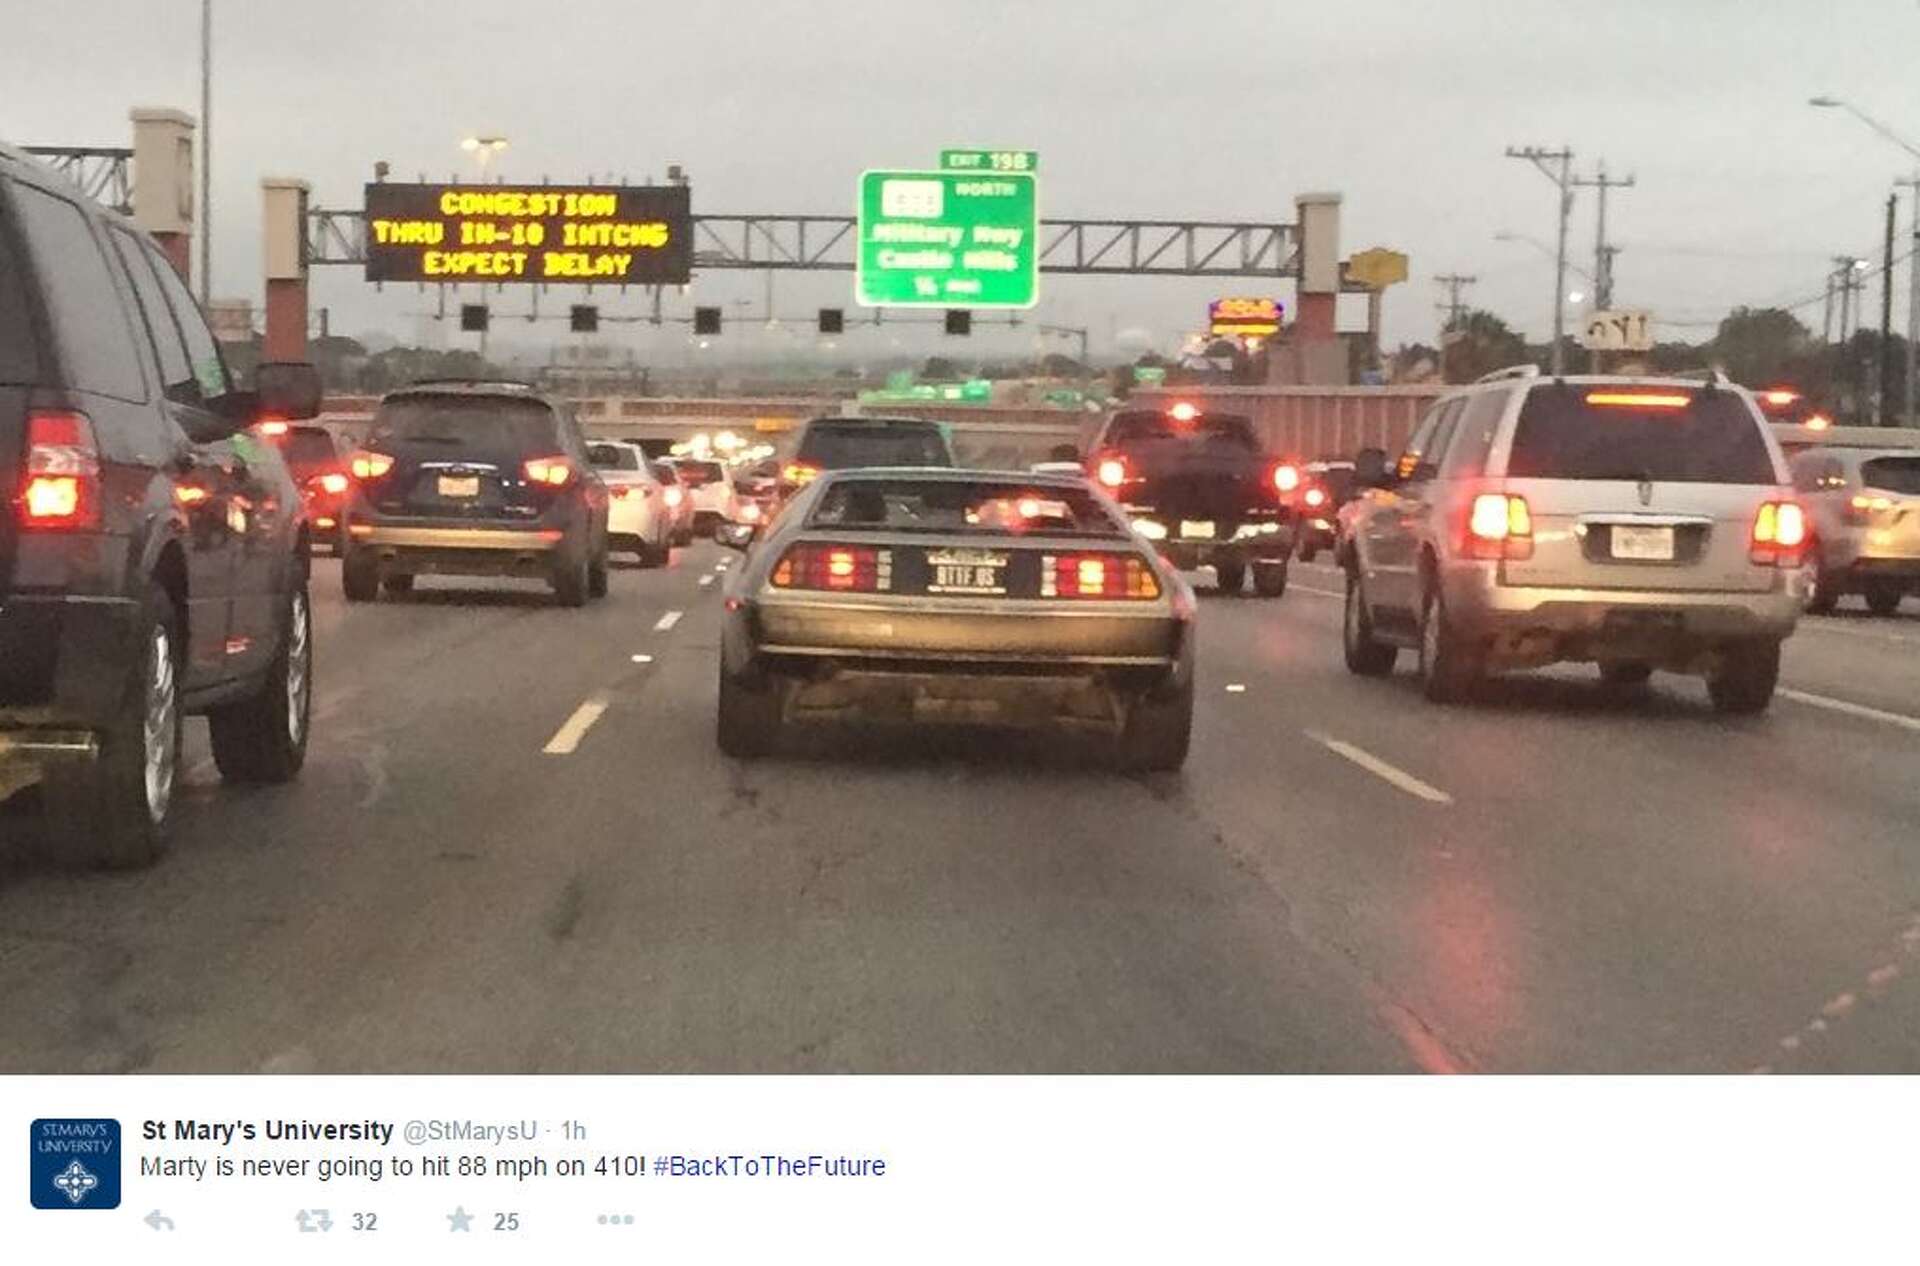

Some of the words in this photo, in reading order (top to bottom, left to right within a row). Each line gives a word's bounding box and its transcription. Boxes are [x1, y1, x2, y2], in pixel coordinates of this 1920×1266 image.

[440, 192, 618, 217] CONGESTION
[373, 220, 444, 244] THRU
[423, 251, 528, 275] EXPECT
[543, 252, 632, 276] DELAY
